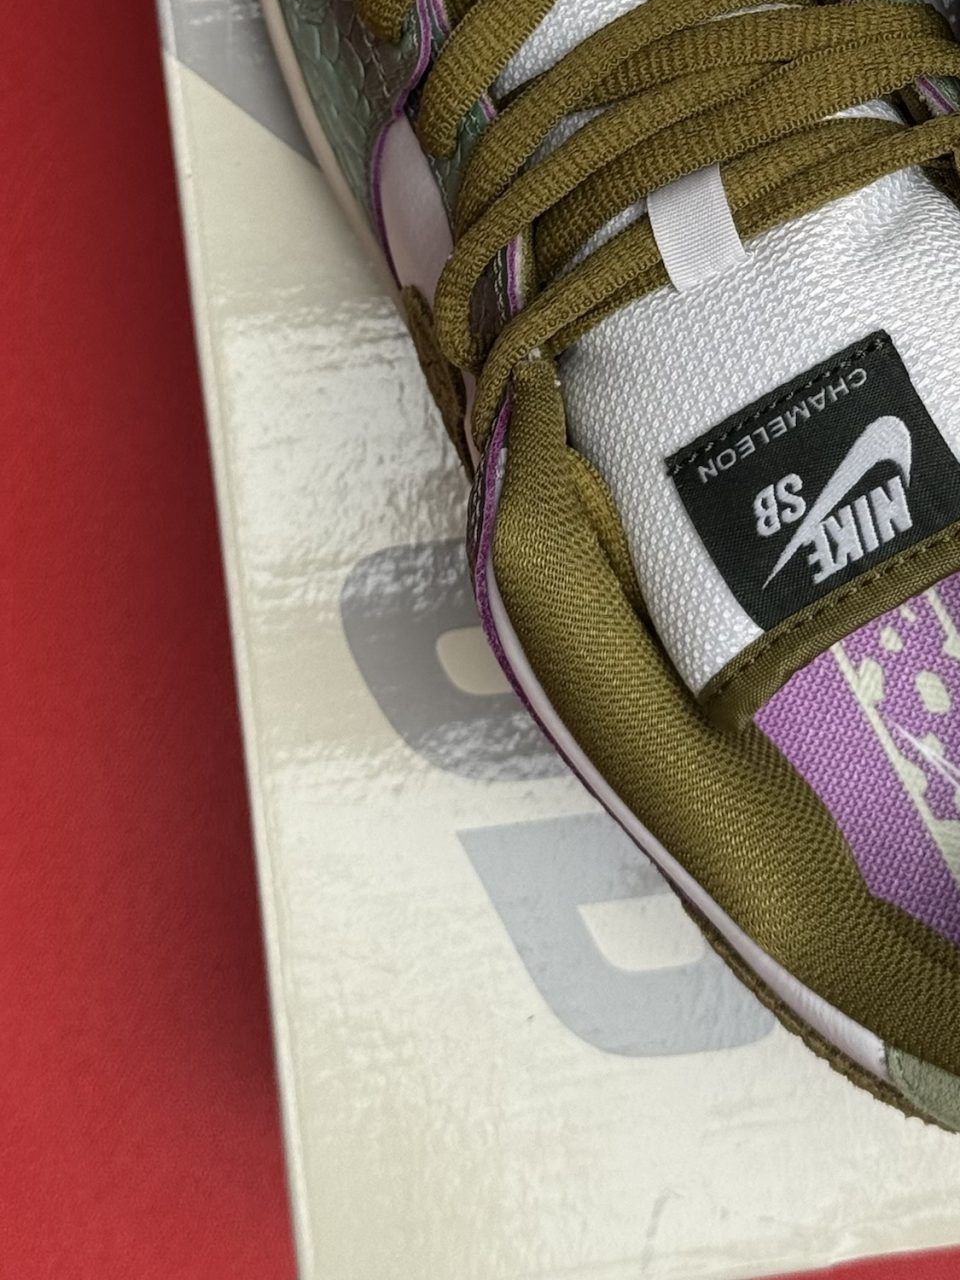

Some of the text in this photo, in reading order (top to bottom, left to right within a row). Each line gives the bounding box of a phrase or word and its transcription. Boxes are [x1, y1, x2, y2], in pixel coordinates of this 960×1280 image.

[697, 367, 868, 484] CHAMELEON
[753, 473, 807, 538] SB
[801, 475, 914, 585] NIKE
